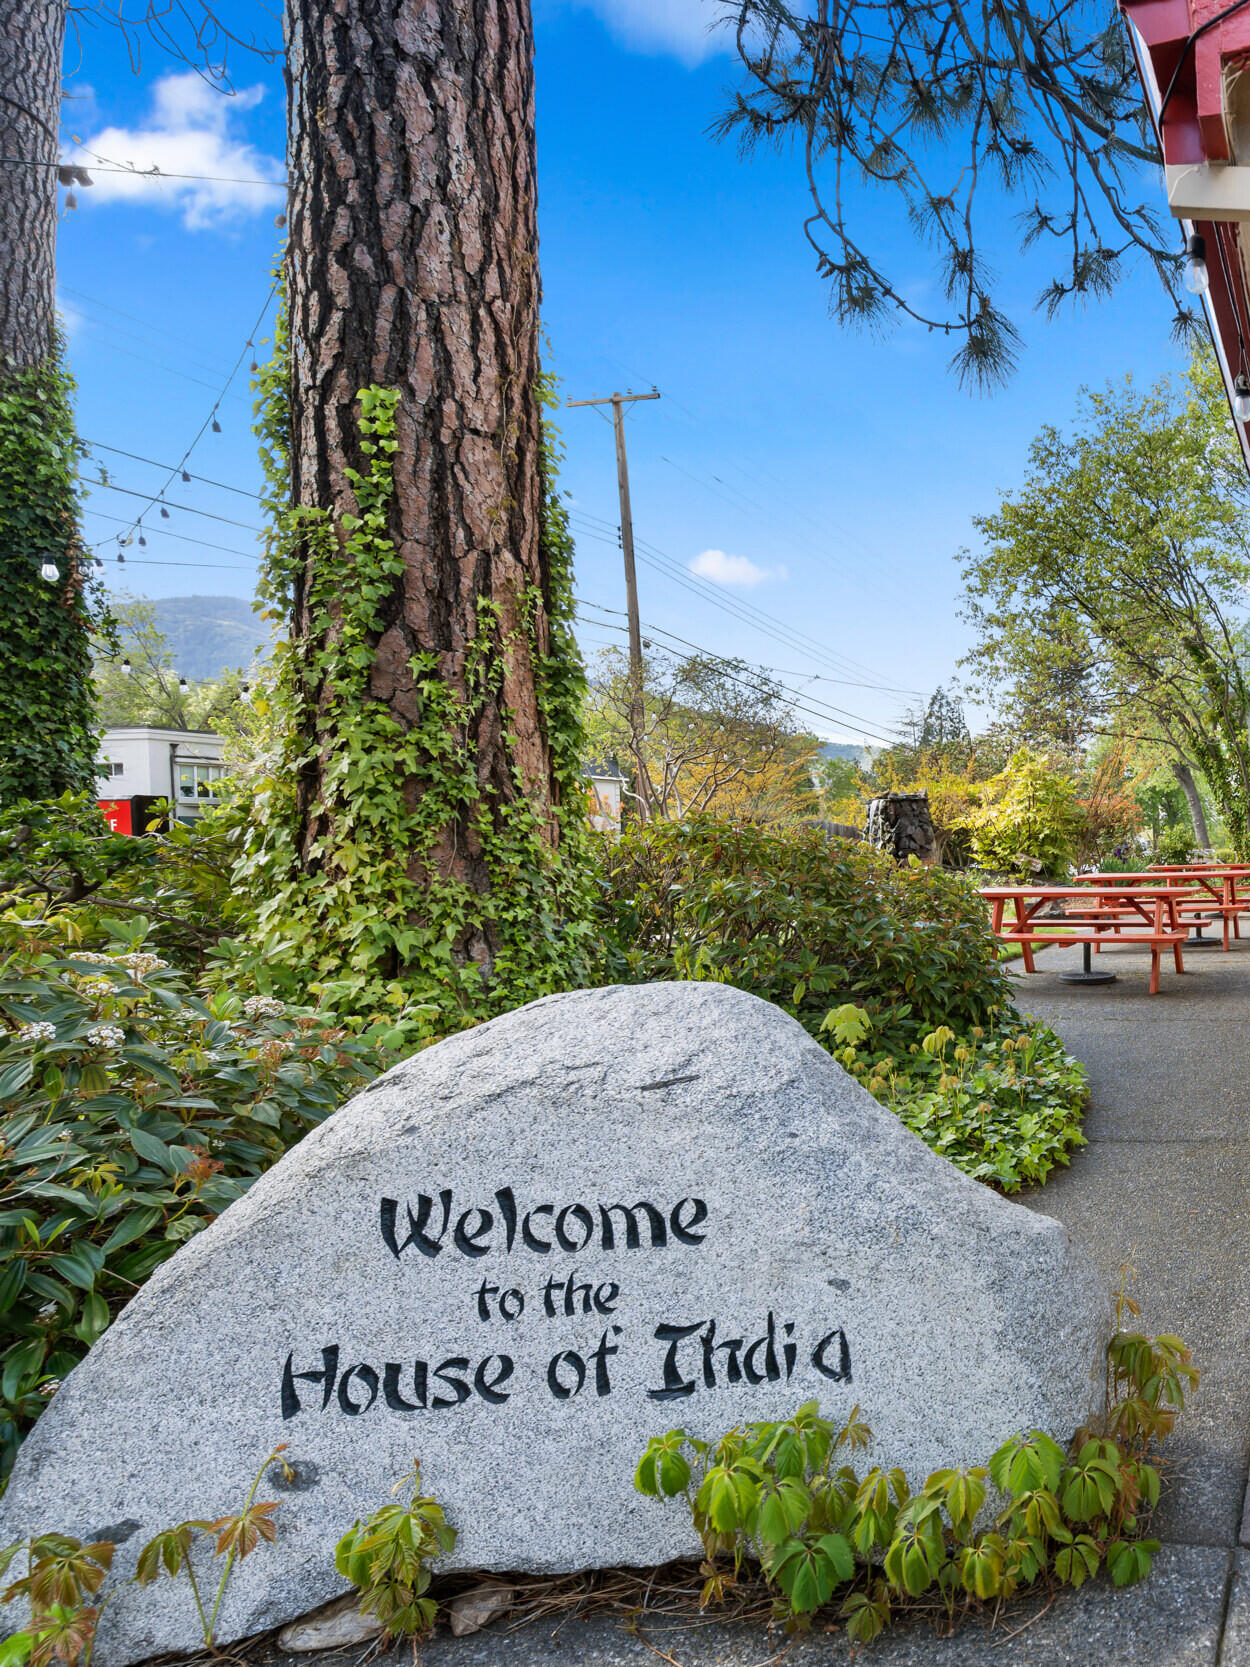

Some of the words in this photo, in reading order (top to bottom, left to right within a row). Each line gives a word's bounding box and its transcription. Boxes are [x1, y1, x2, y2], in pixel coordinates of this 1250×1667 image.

[379, 1185, 709, 1260] Welcome
[472, 1276, 525, 1322] to
[538, 1269, 620, 1318] the
[281, 1343, 514, 1421] House
[546, 1324, 623, 1400] of
[645, 1310, 853, 1400] India
